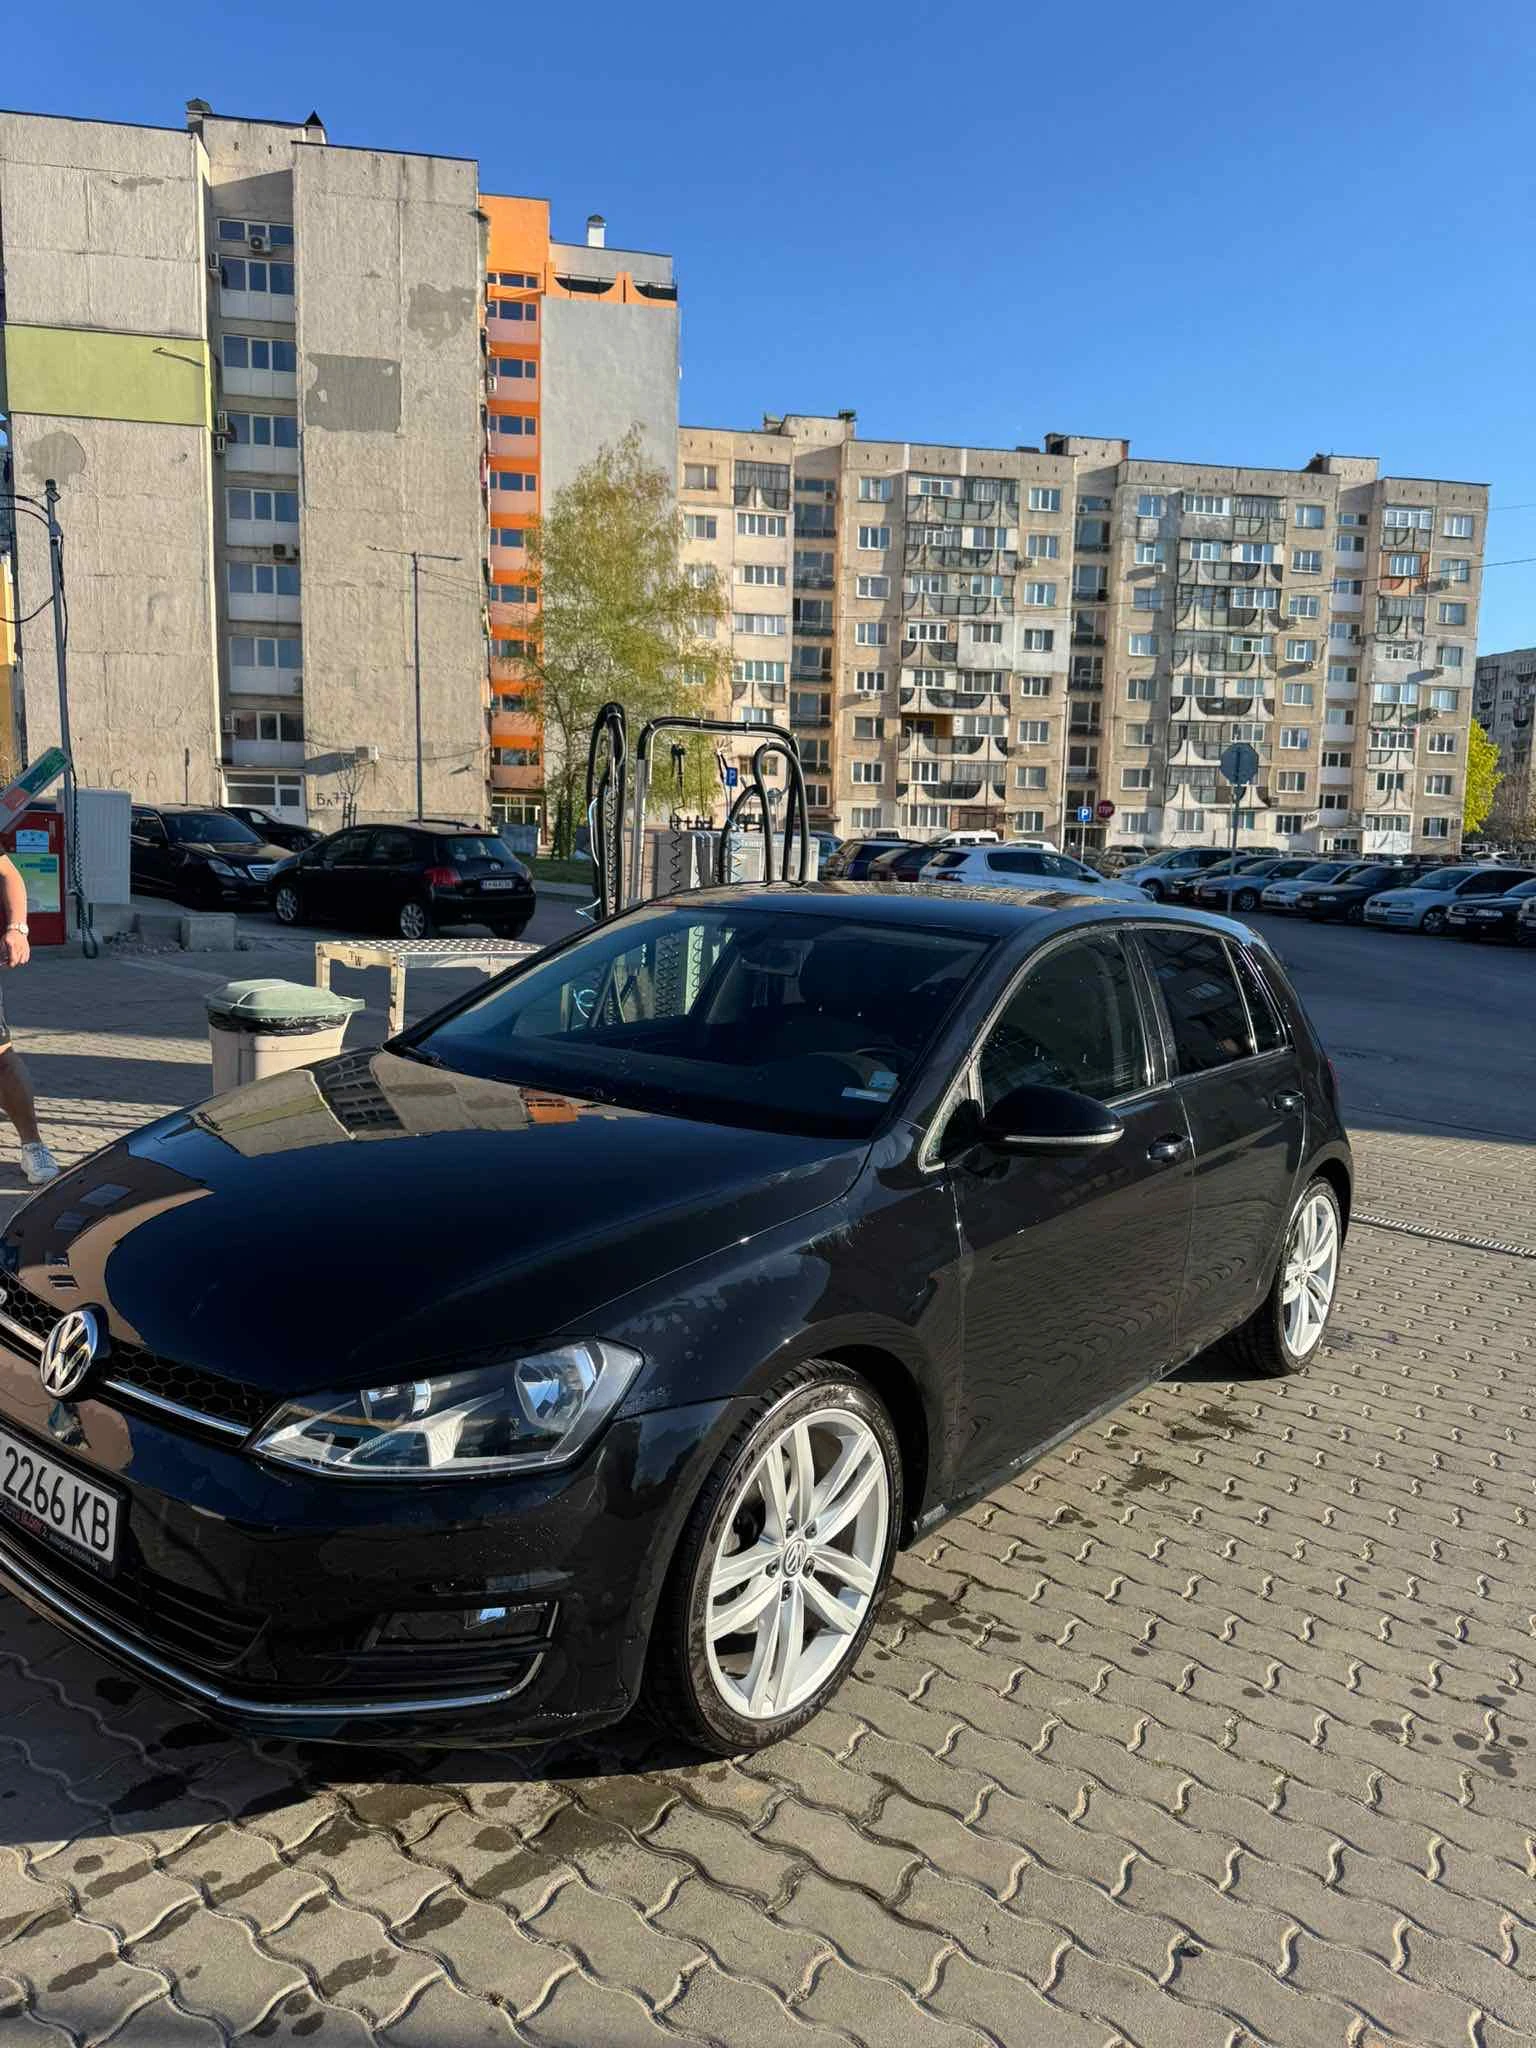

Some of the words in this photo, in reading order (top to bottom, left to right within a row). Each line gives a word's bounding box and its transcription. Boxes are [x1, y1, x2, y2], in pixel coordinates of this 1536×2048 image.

[1081, 808, 1089, 819] P
[3, 1446, 66, 1526] 2266
[71, 1485, 110, 1553] KB
